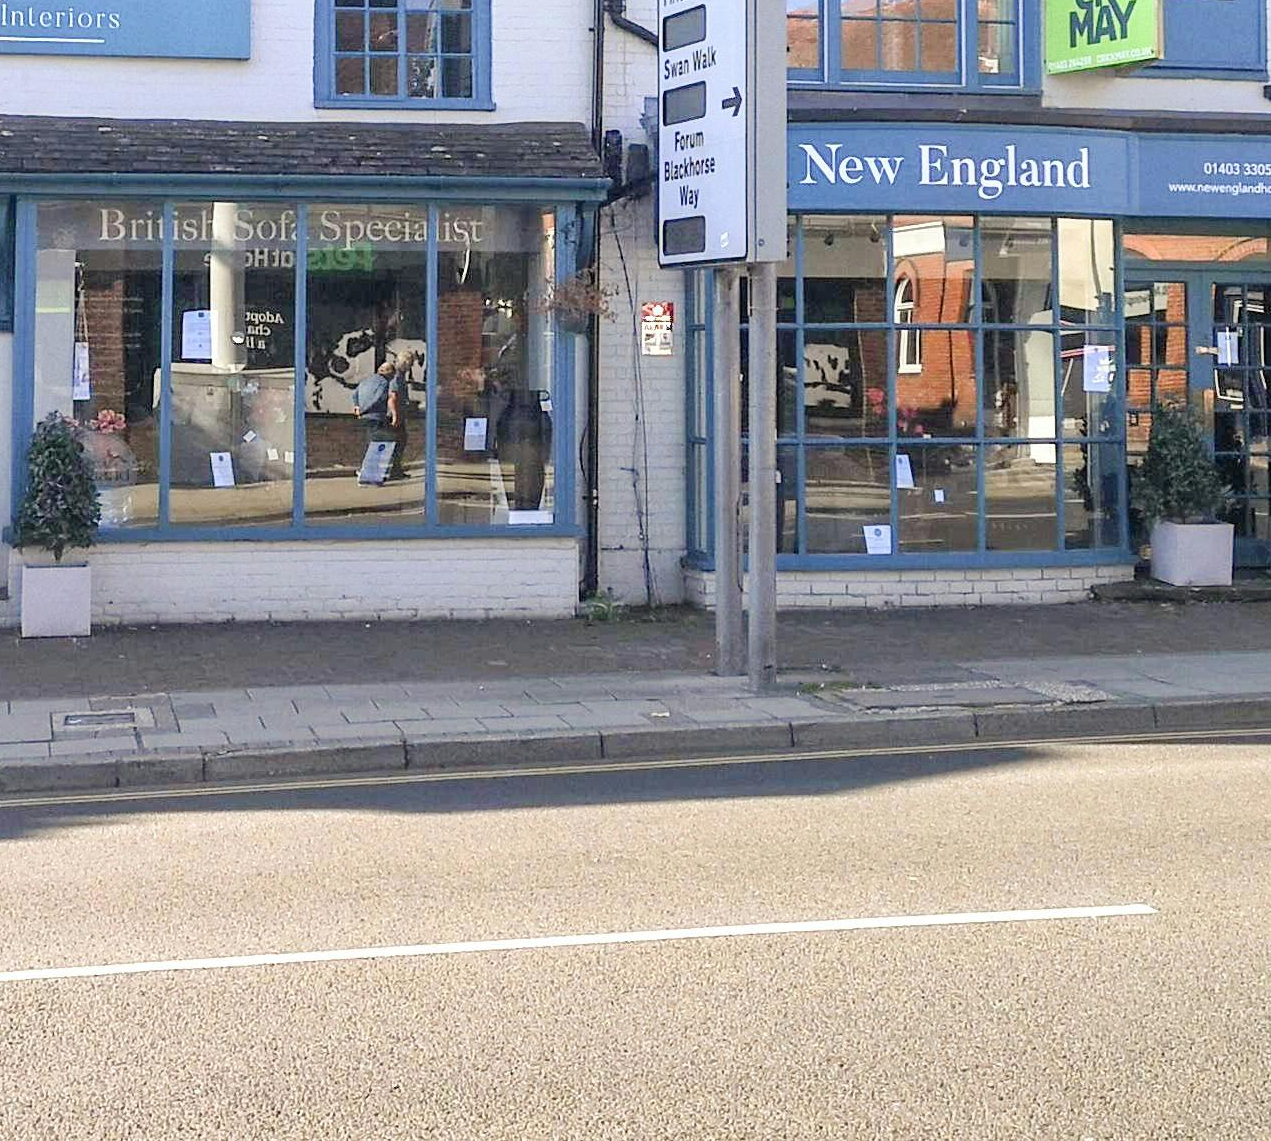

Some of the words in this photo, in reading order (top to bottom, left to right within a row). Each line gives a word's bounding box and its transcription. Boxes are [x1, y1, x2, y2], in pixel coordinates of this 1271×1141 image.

[1, 4, 122, 30] Interiors
[1070, 0, 1137, 48] MAY
[663, 58, 690, 79] Swan
[692, 45, 717, 72] Walk
[674, 131, 704, 152] Forum
[664, 156, 716, 182] Blackhorse
[799, 143, 904, 185] New
[919, 144, 1091, 200] England
[1203, 162, 1240, 175] 01403
[679, 184, 699, 209] Way
[320, 210, 484, 250] Specialist
